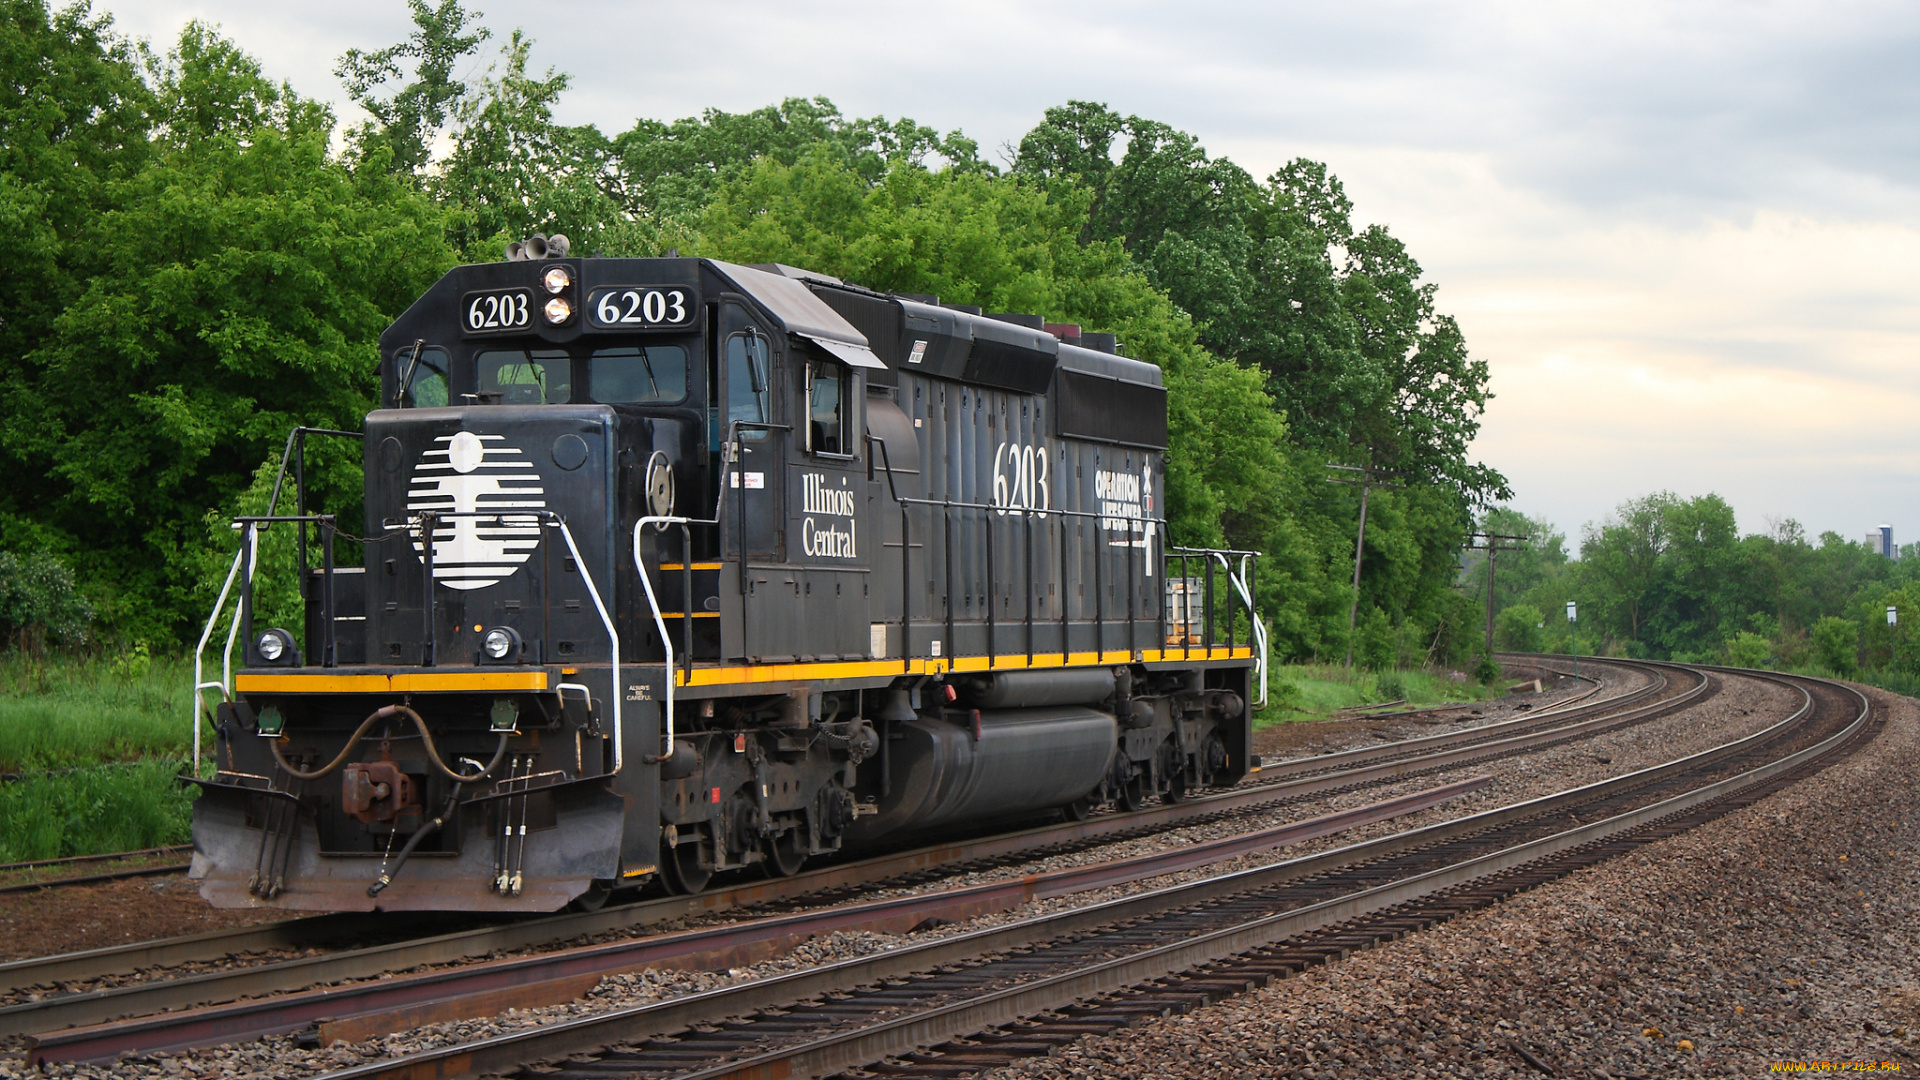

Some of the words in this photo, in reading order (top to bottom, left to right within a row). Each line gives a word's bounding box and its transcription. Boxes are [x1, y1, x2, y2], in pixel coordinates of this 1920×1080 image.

[469, 293, 529, 329] 6203
[597, 290, 686, 324] 6203
[802, 472, 855, 517] Illinois
[992, 442, 1049, 519] 6203
[1095, 469, 1140, 503] OPERATION
[802, 516, 857, 559] Central
